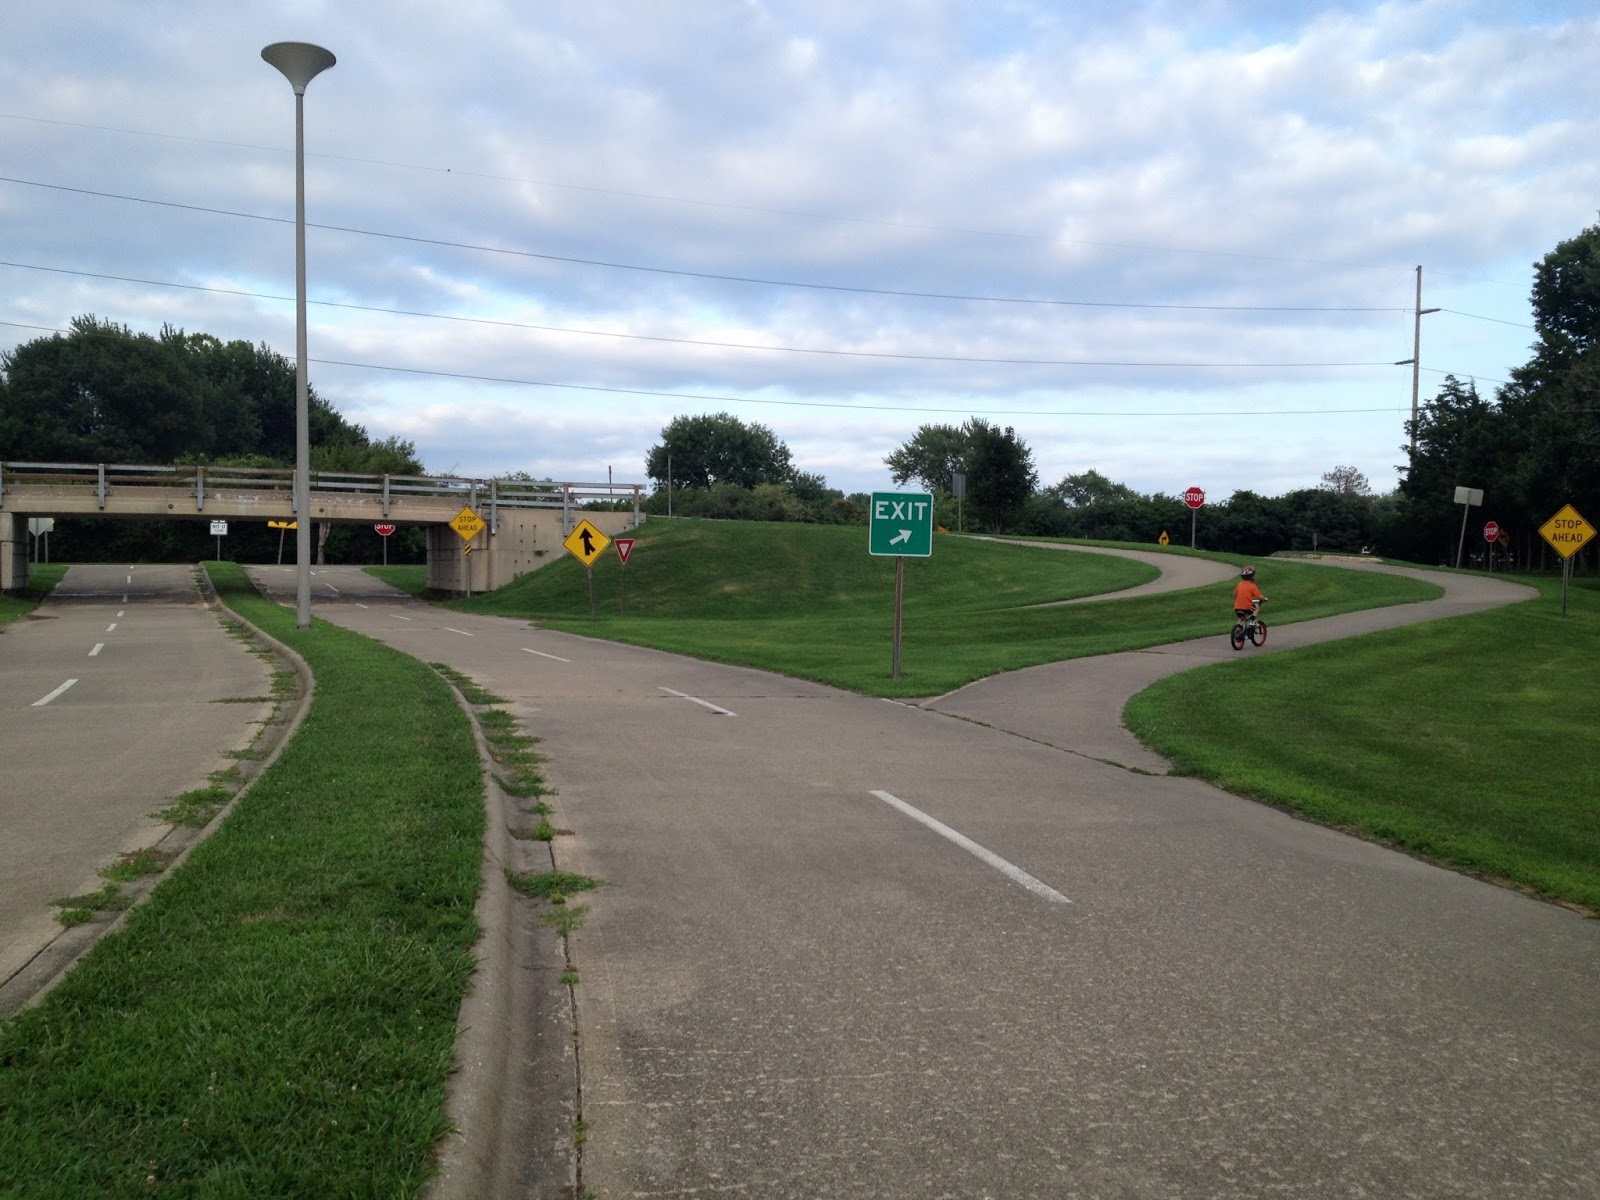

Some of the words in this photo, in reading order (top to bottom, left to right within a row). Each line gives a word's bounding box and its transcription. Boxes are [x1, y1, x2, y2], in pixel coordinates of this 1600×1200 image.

[1186, 493, 1203, 502] STOP
[875, 500, 928, 521] EXIT
[1554, 519, 1582, 529] STOP
[1485, 527, 1498, 536] STOP
[1552, 533, 1583, 543] AHEAD
